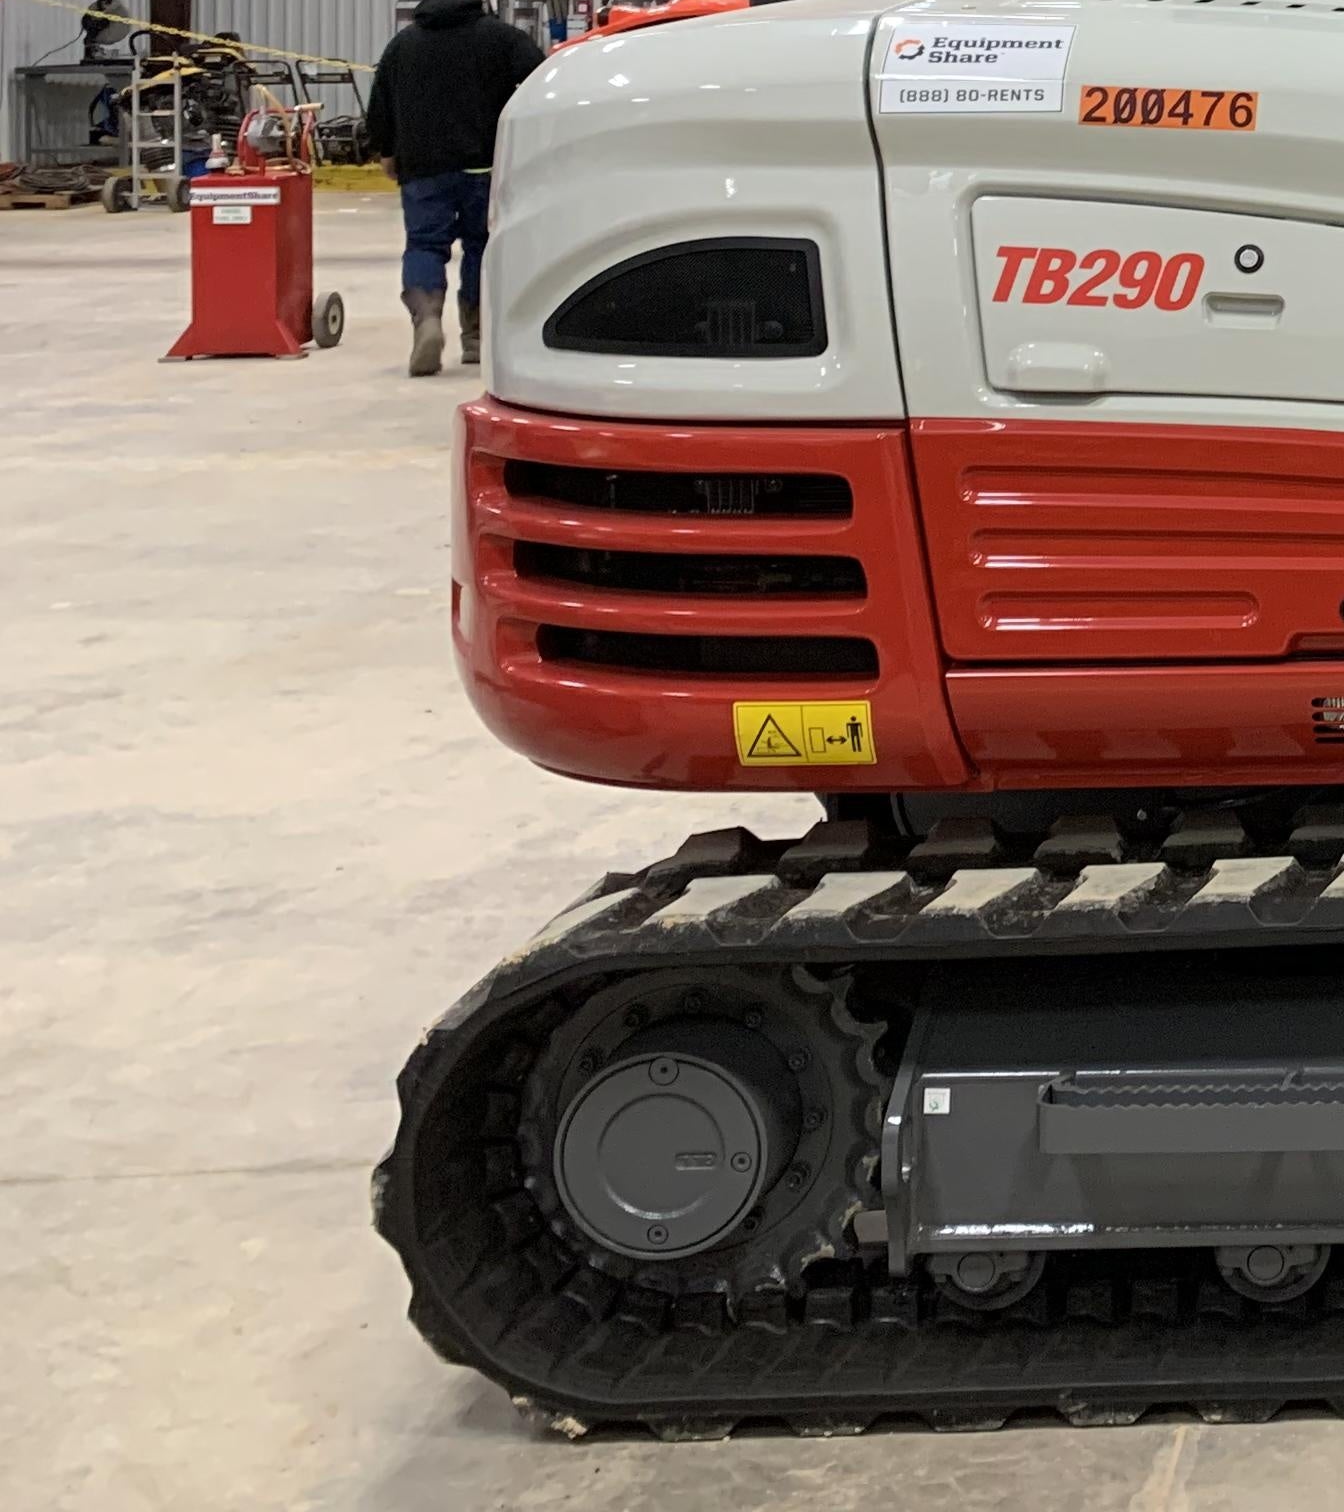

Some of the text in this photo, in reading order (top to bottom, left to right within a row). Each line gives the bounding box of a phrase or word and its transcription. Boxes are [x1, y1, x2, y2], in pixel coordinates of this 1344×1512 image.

[932, 37, 1064, 51] Equipment
[928, 51, 998, 64] Share
[899, 88, 1045, 103] (888) 80-RENTS
[1081, 86, 1254, 128] 200476
[992, 245, 1205, 311] TB290
